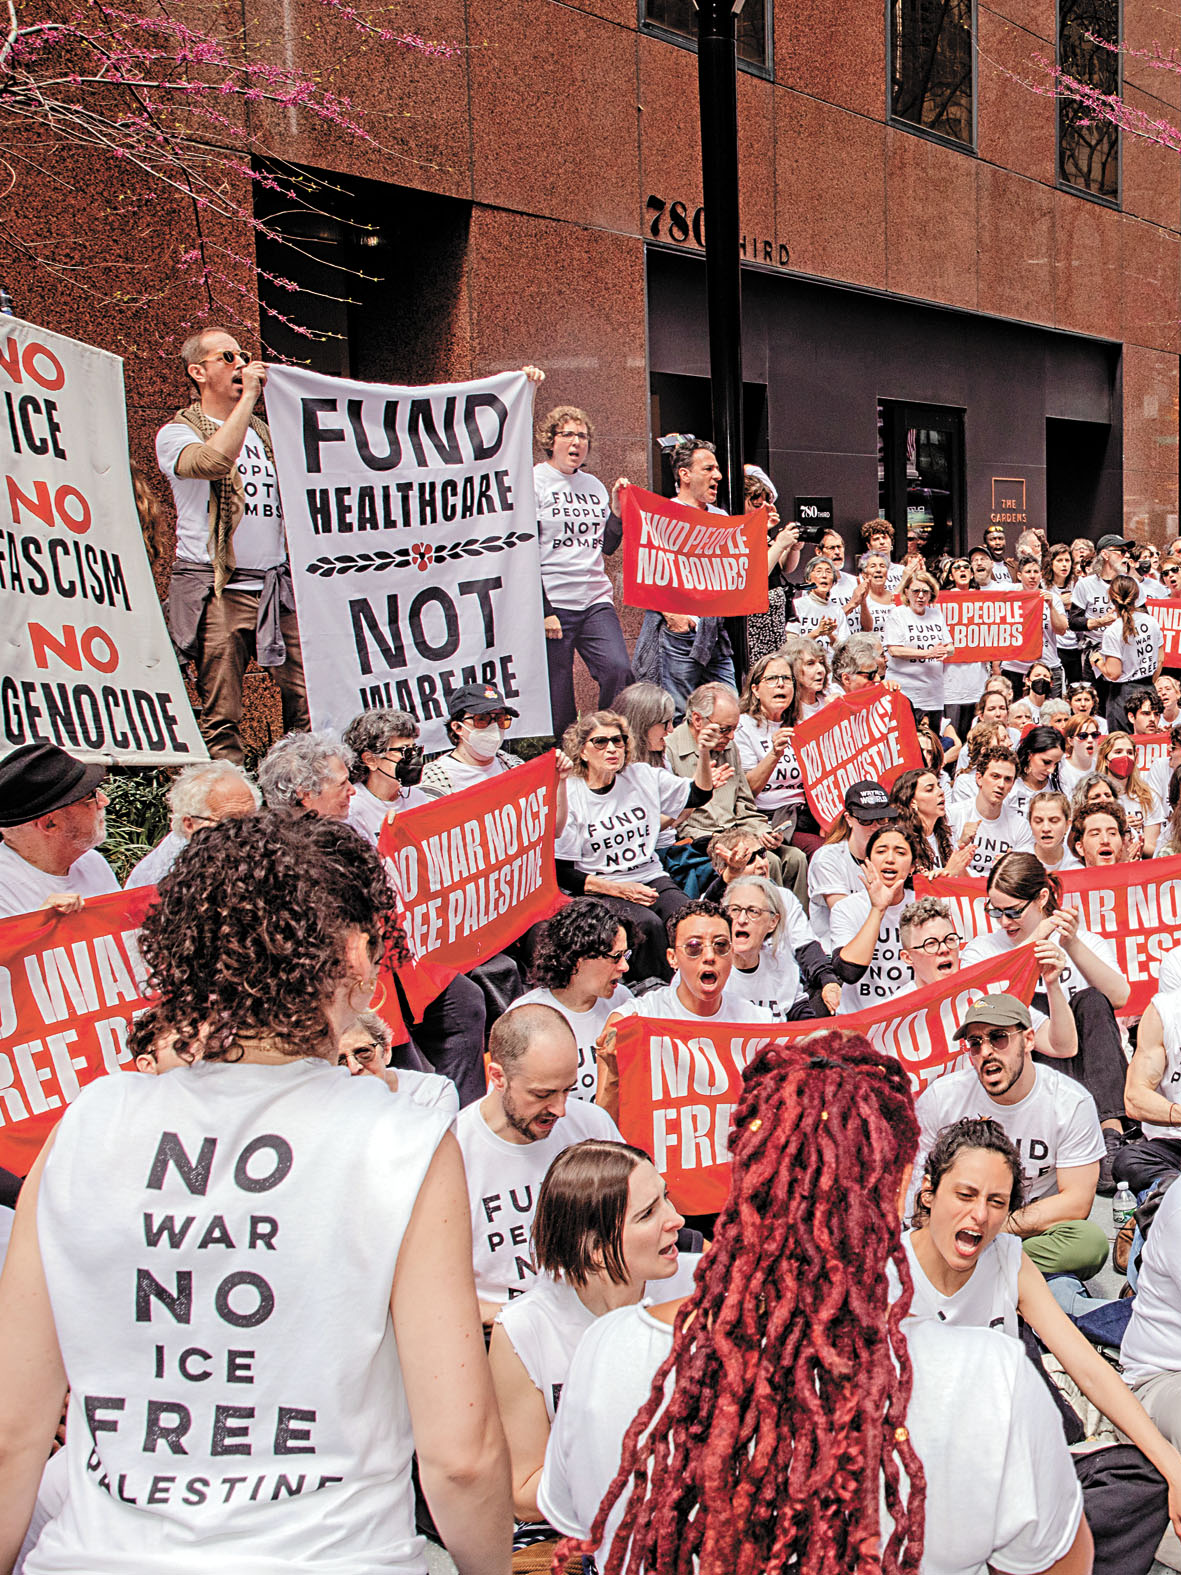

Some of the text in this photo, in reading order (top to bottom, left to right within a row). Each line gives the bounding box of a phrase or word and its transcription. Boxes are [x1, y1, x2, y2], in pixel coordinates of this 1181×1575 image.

[739, 235, 789, 265] HIRD
[7, 394, 66, 461] ICE
[300, 392, 509, 474] FUND
[6, 473, 92, 535] NO
[244, 482, 274, 498] OT
[305, 469, 515, 536] HEALTHCARE
[552, 491, 600, 505] FUND
[1001, 499, 1017, 509] THE
[552, 507, 606, 519] PEOPLE
[800, 506, 817, 518] 780
[990, 513, 1028, 523] GARDENS
[564, 521, 600, 534] NOT
[640, 511, 750, 555] FUND PEOPLE
[552, 537, 604, 550] BOMBS
[636, 548, 749, 591] NOT BOMBS
[962, 602, 1024, 624] PEOPLE
[1094, 597, 1110, 605] FU
[348, 576, 503, 676] NOT
[801, 617, 819, 626] FU
[908, 624, 943, 633] FUND
[954, 624, 1023, 647] BOMBS
[28, 621, 120, 674] NO
[1136, 635, 1151, 645] WAR
[1137, 644, 1153, 658] NO
[1131, 661, 1157, 677] FREE
[358, 655, 521, 722] WARFRE
[2, 676, 190, 753] GENOCIDE
[776, 767, 800, 780] NO
[588, 807, 646, 838] FUND
[421, 820, 485, 893] WAR
[484, 804, 518, 864] NO
[591, 824, 650, 853] PEOPLE
[972, 836, 1009, 853] UND
[606, 842, 647, 867] NOT
[1060, 889, 1118, 933] AR
[869, 967, 915, 981] NOT
[0, 1029, 88, 1128] REE
[649, 1035, 730, 1101] NO
[653, 1104, 738, 1174] FRE
[145, 1131, 294, 1197] NO
[482, 1185, 532, 1223] FU
[143, 1212, 280, 1251] WAR
[135, 1268, 275, 1329] NO
[155, 1344, 256, 1385] ICE
[84, 1395, 317, 1457] FREE
